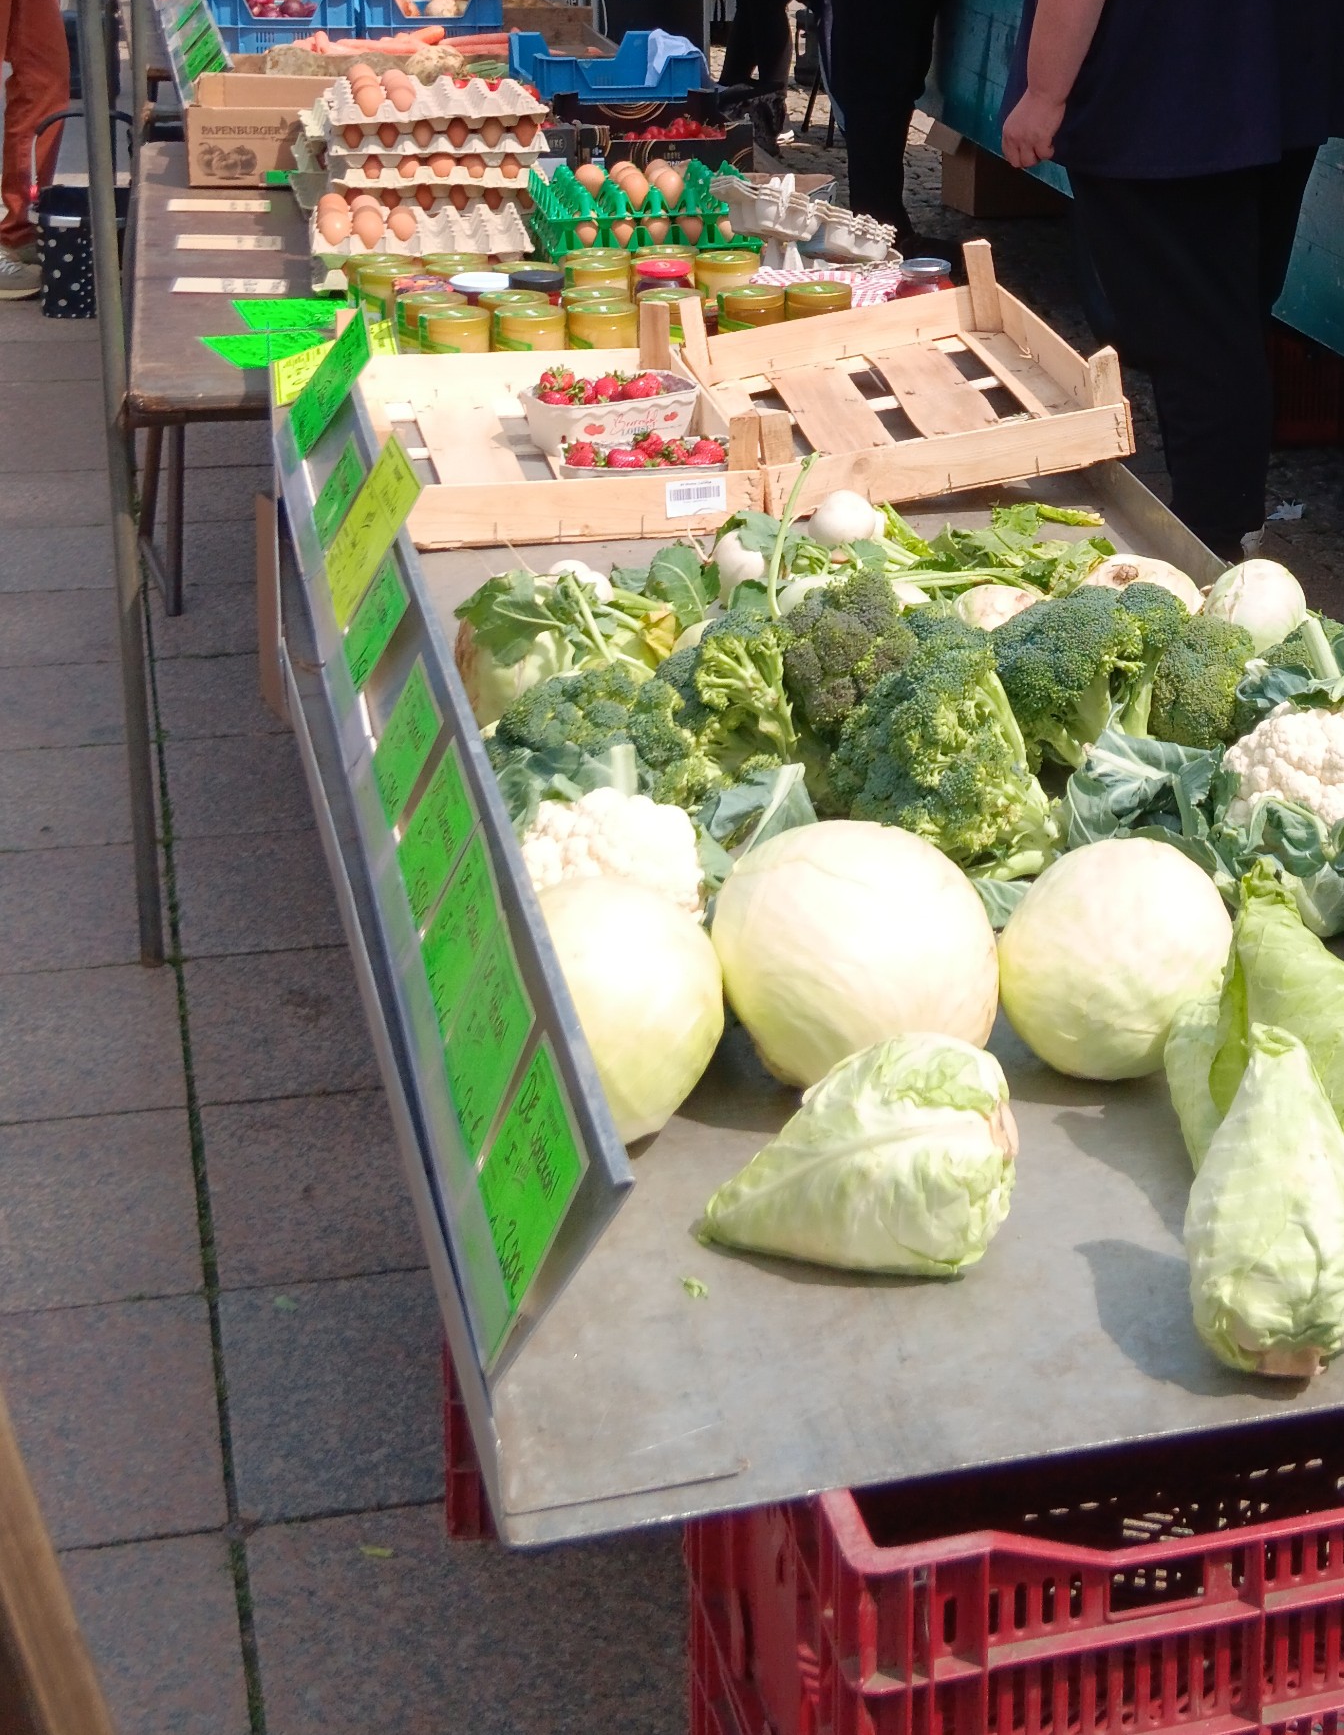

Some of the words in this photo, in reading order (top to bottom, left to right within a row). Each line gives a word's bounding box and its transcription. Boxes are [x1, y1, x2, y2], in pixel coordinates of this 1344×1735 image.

[201, 125, 282, 136] PAPENBURGER
[519, 1070, 541, 1124] DE
[530, 1119, 561, 1202] Spitzkohl
